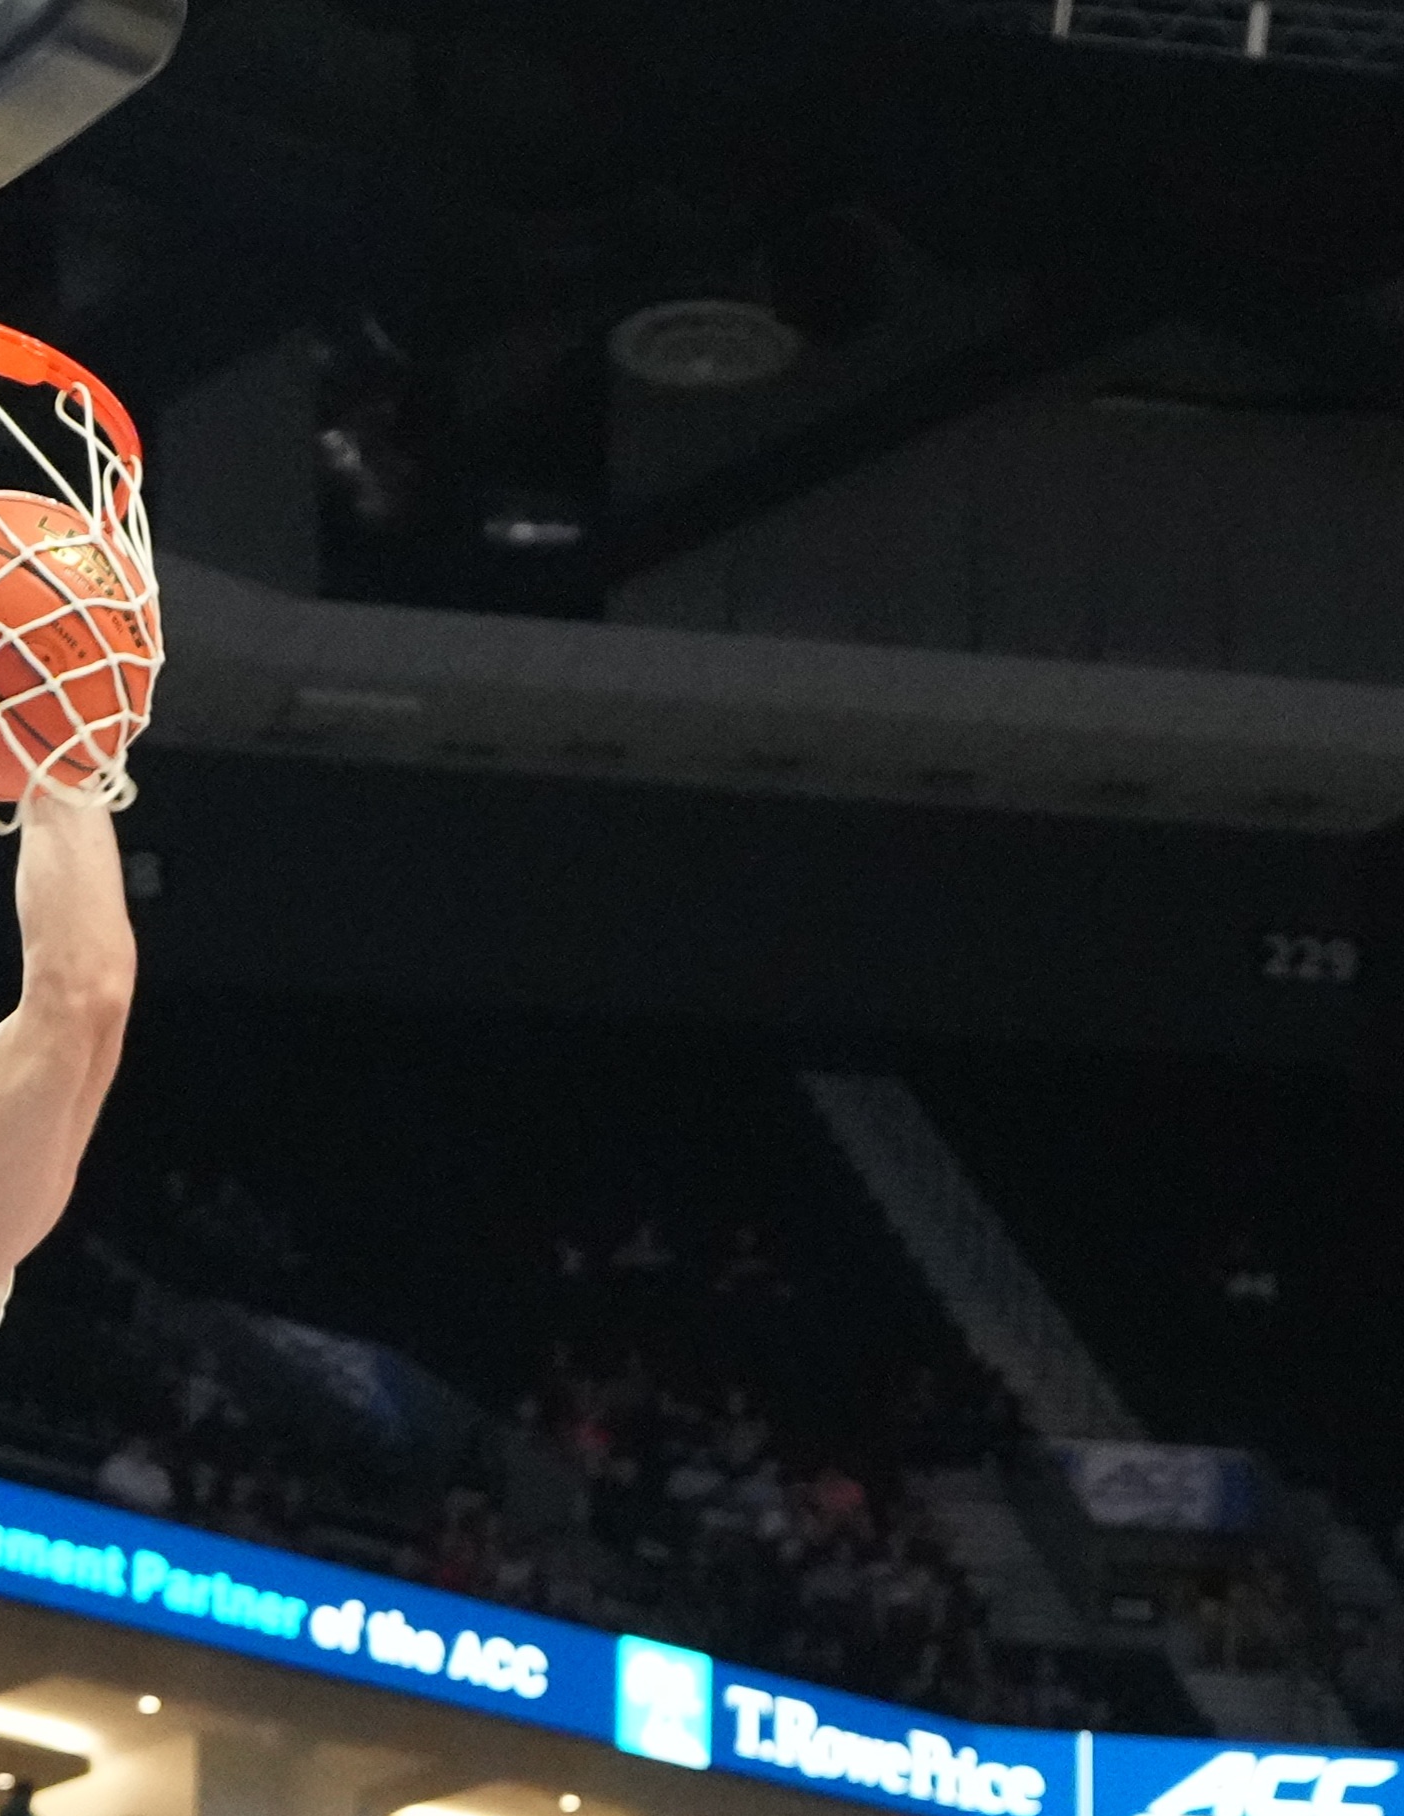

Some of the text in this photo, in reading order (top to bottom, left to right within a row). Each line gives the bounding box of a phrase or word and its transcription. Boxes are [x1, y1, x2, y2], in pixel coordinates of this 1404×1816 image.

[132, 1549, 307, 1639] Partner
[309, 1599, 365, 1655] of
[367, 1611, 444, 1675] the
[446, 1630, 548, 1699] ACC
